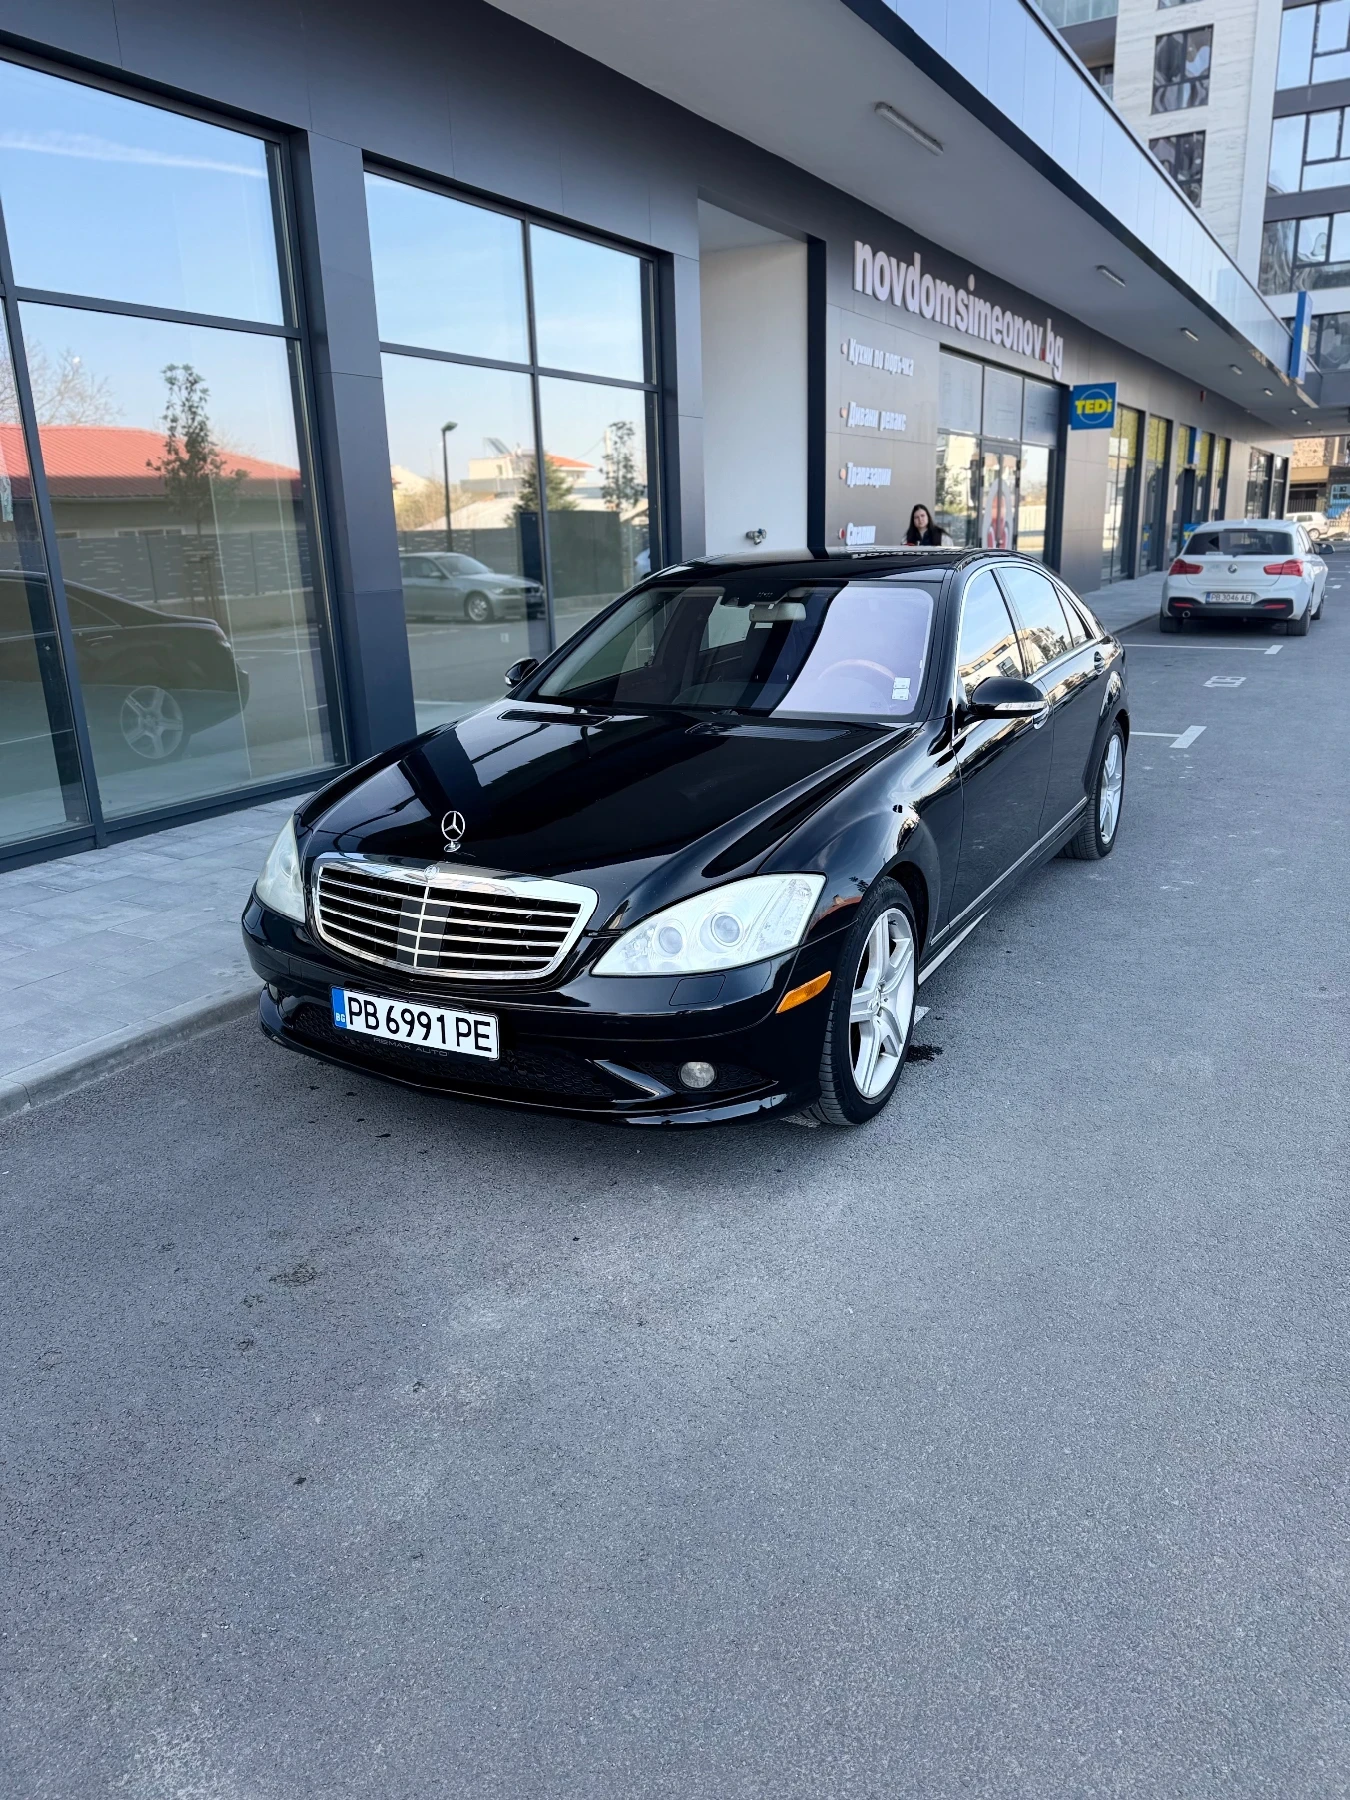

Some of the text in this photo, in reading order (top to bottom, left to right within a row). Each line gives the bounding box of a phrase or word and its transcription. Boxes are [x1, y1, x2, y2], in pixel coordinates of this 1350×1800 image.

[853, 240, 1064, 381] novdomsimeonov.bg
[848, 338, 915, 377] Кухни по поръчка
[848, 400, 907, 432] Дивани релакс
[1075, 398, 1113, 415] TEDi
[335, 1012, 346, 1023] BG
[347, 996, 493, 1052] PB 6991 PE
